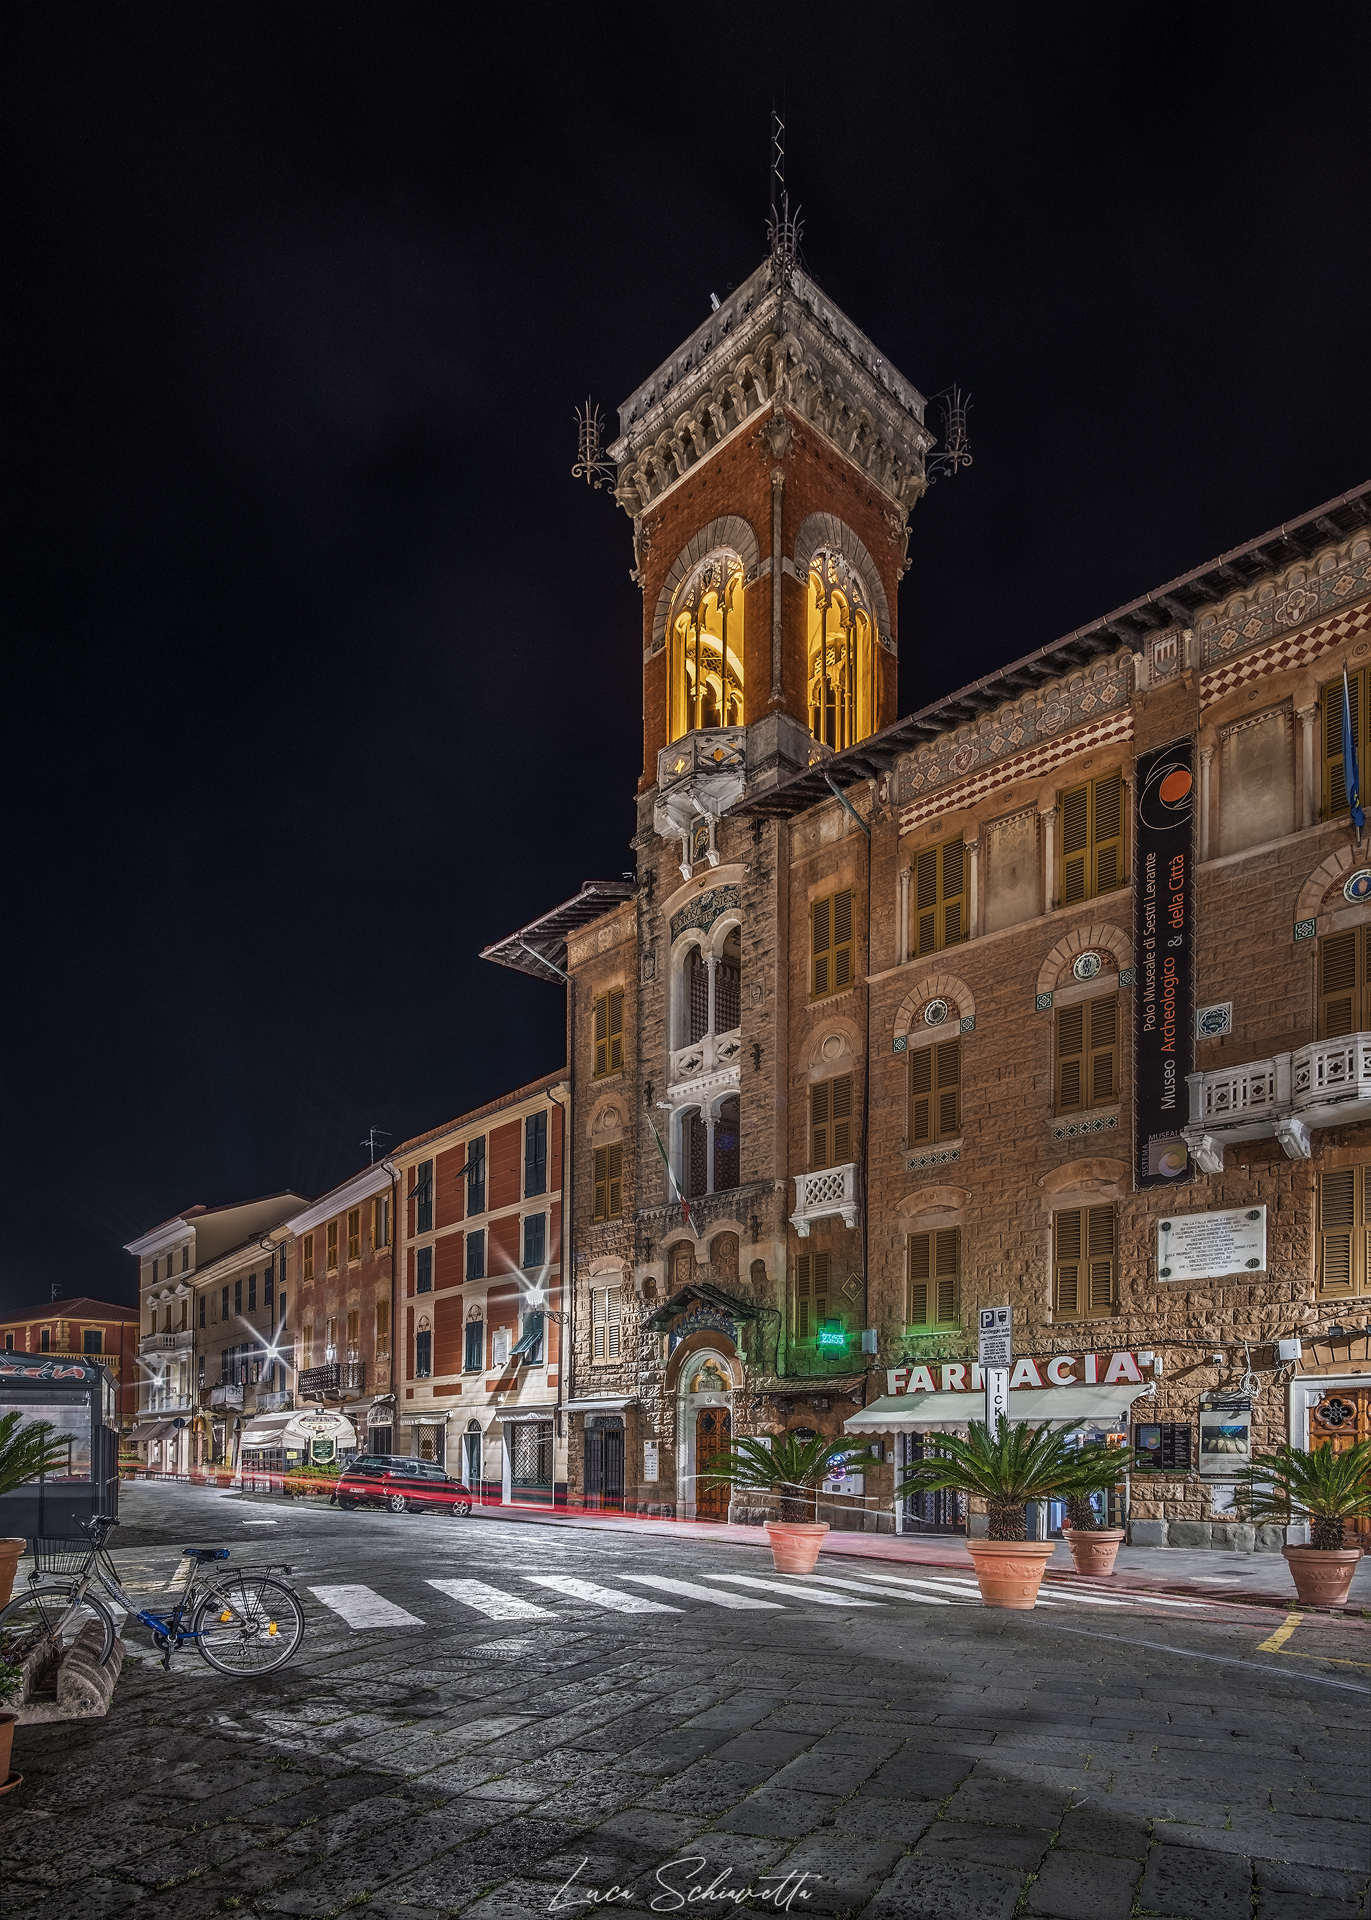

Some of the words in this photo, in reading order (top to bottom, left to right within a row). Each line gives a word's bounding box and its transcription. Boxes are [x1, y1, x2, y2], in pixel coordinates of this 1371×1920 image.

[1144, 852, 1156, 901] Levante
[1168, 854, 1184, 891] Città
[1144, 901, 1156, 936] Sestri
[1168, 892, 1184, 929] della
[1143, 936, 1156, 950] di
[1167, 934, 1183, 947] &
[1143, 951, 1156, 1002] Museale
[1143, 1004, 1156, 1032] Polo
[1160, 956, 1179, 1052] Archeologico
[1160, 1059, 1176, 1110] Museo
